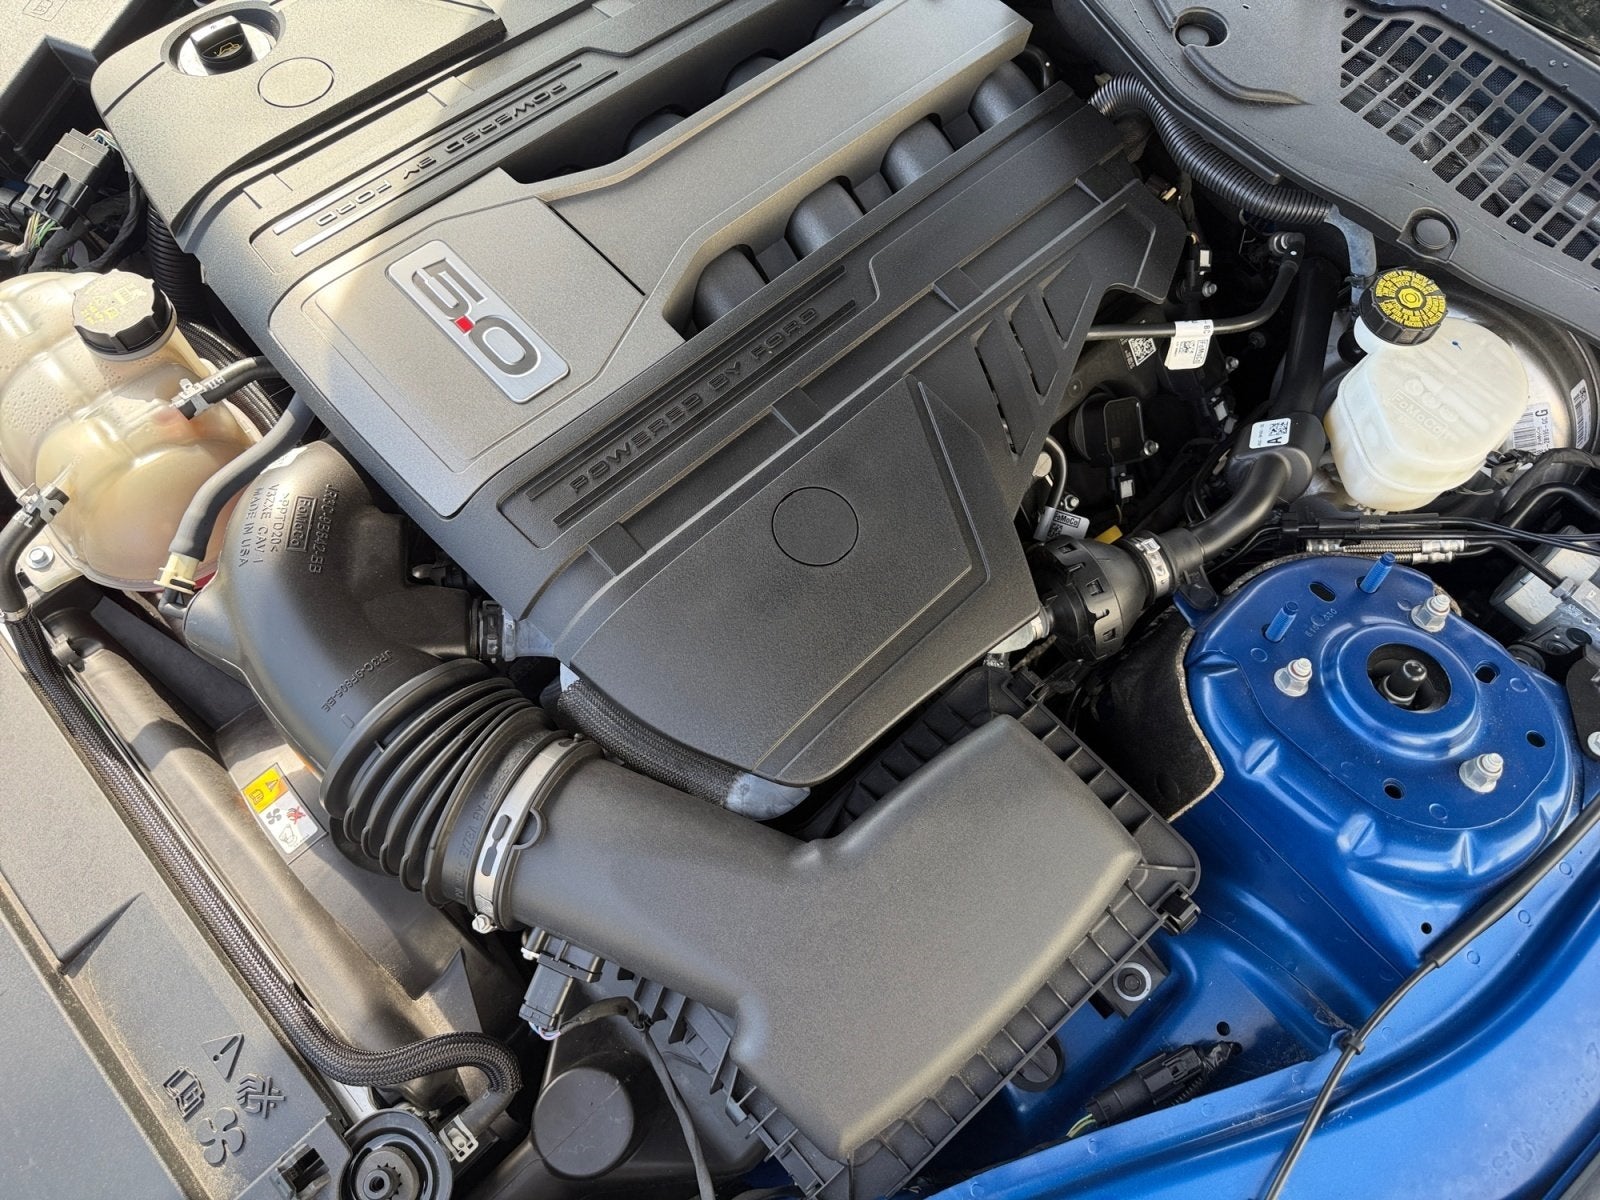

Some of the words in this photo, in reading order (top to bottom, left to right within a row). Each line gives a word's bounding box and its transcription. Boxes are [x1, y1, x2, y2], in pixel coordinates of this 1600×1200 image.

[445, 81, 568, 154] POWERED
[402, 154, 437, 180] BY
[315, 178, 393, 227] FORD
[411, 257, 542, 378] 5.0
[569, 392, 703, 494] POWERED
[707, 360, 742, 391] BY
[751, 306, 818, 360] FORD
[1391, 392, 1443, 435] FoMoCo
[1267, 436, 1282, 444] A
[246, 486, 265, 521] MADE
[289, 499, 313, 548] FoMoCo
[243, 522, 255, 536] IN
[238, 537, 252, 568] USA
